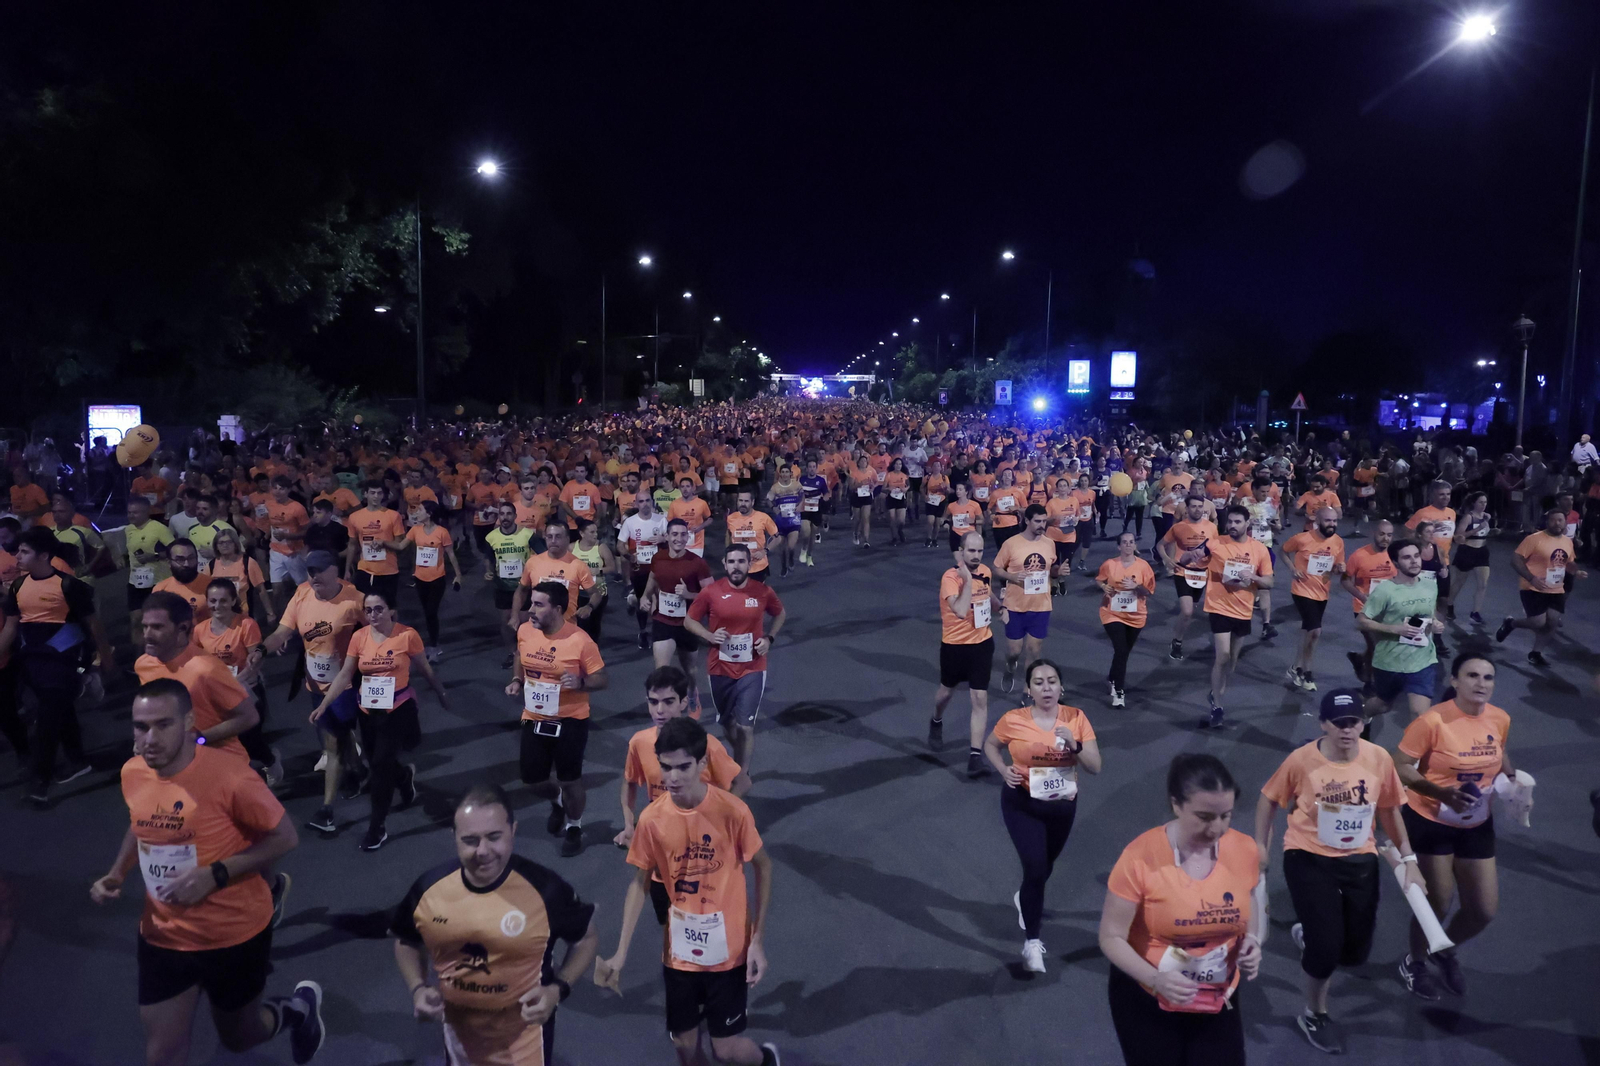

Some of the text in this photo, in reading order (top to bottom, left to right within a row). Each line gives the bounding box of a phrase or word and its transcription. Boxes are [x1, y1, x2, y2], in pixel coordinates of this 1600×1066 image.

[664, 600, 681, 608] 15443
[726, 643, 748, 652] 15438
[313, 662, 331, 671] 7682
[367, 686, 385, 696] 7683
[532, 691, 549, 702] 2611
[1043, 779, 1066, 791] 9831
[1335, 819, 1364, 831] 2844
[1197, 907, 1240, 918] NOCTURNA
[684, 925, 709, 943] 5847
